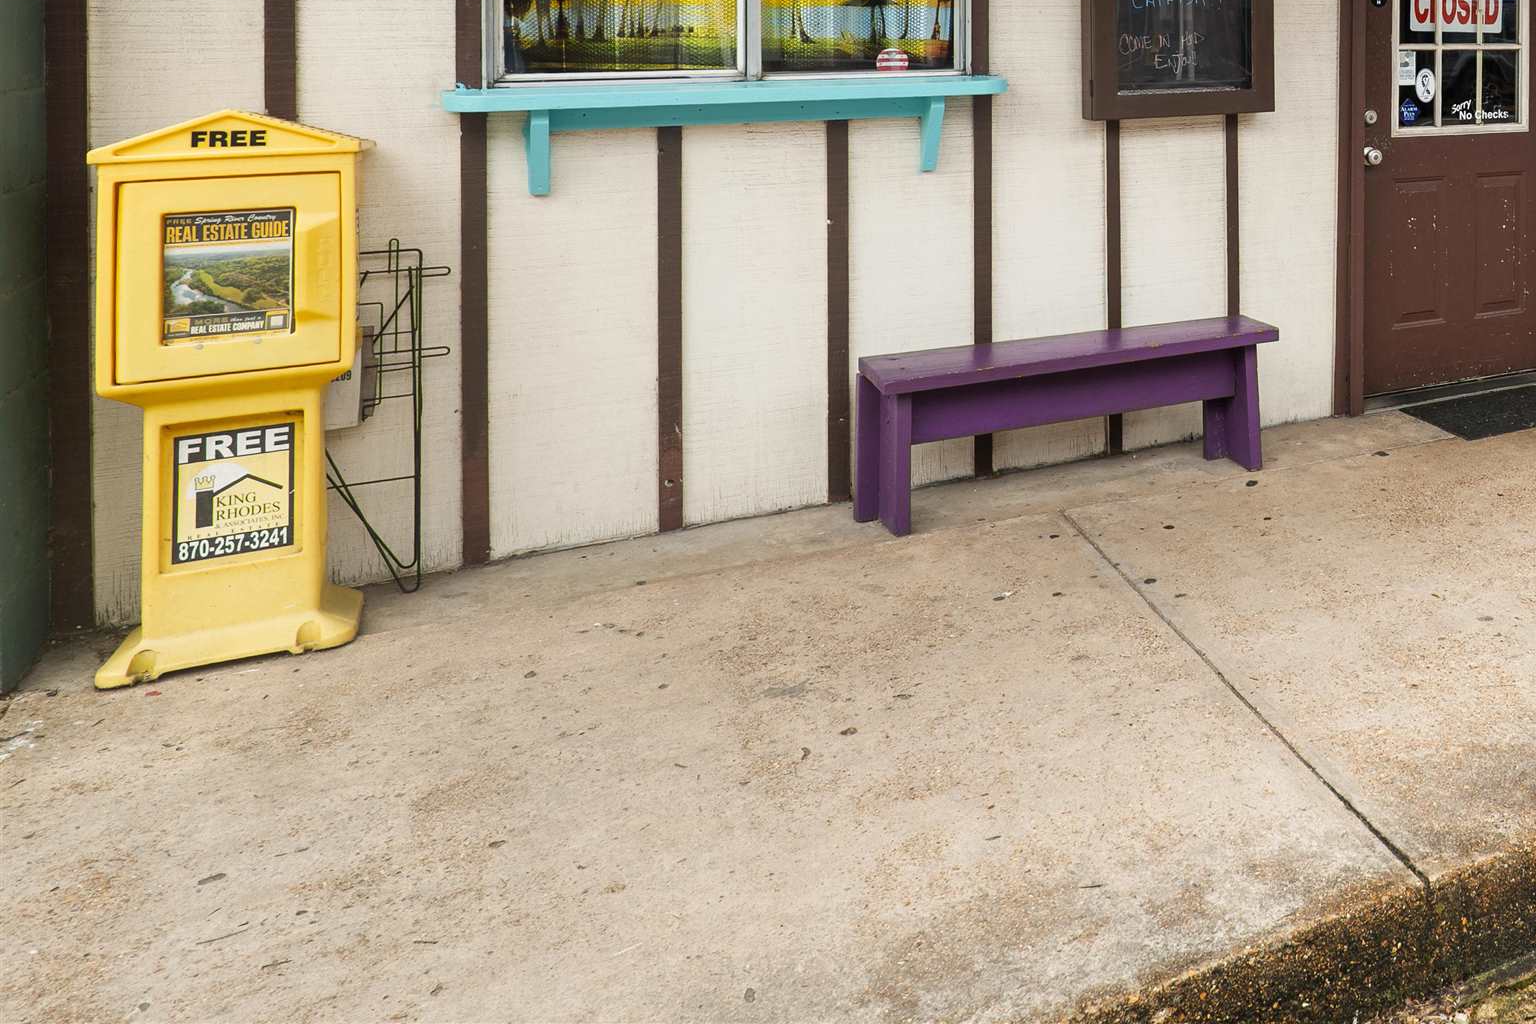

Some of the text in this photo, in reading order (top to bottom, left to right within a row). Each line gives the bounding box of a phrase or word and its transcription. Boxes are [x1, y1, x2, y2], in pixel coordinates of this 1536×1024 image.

[1451, 99, 1472, 114] Sorry
[1459, 110, 1509, 120] No Checks
[191, 130, 267, 148] FREE
[194, 216, 222, 225] Spring
[166, 220, 289, 244] REAL ESTATE GUIDE
[190, 325, 207, 335] REAL
[208, 323, 232, 333] ESTATE
[233, 321, 265, 331] COMPANY
[178, 426, 290, 464] FREE
[216, 492, 256, 508] KING
[216, 501, 281, 521] RHODES
[179, 527, 288, 561] 870-257-3241
